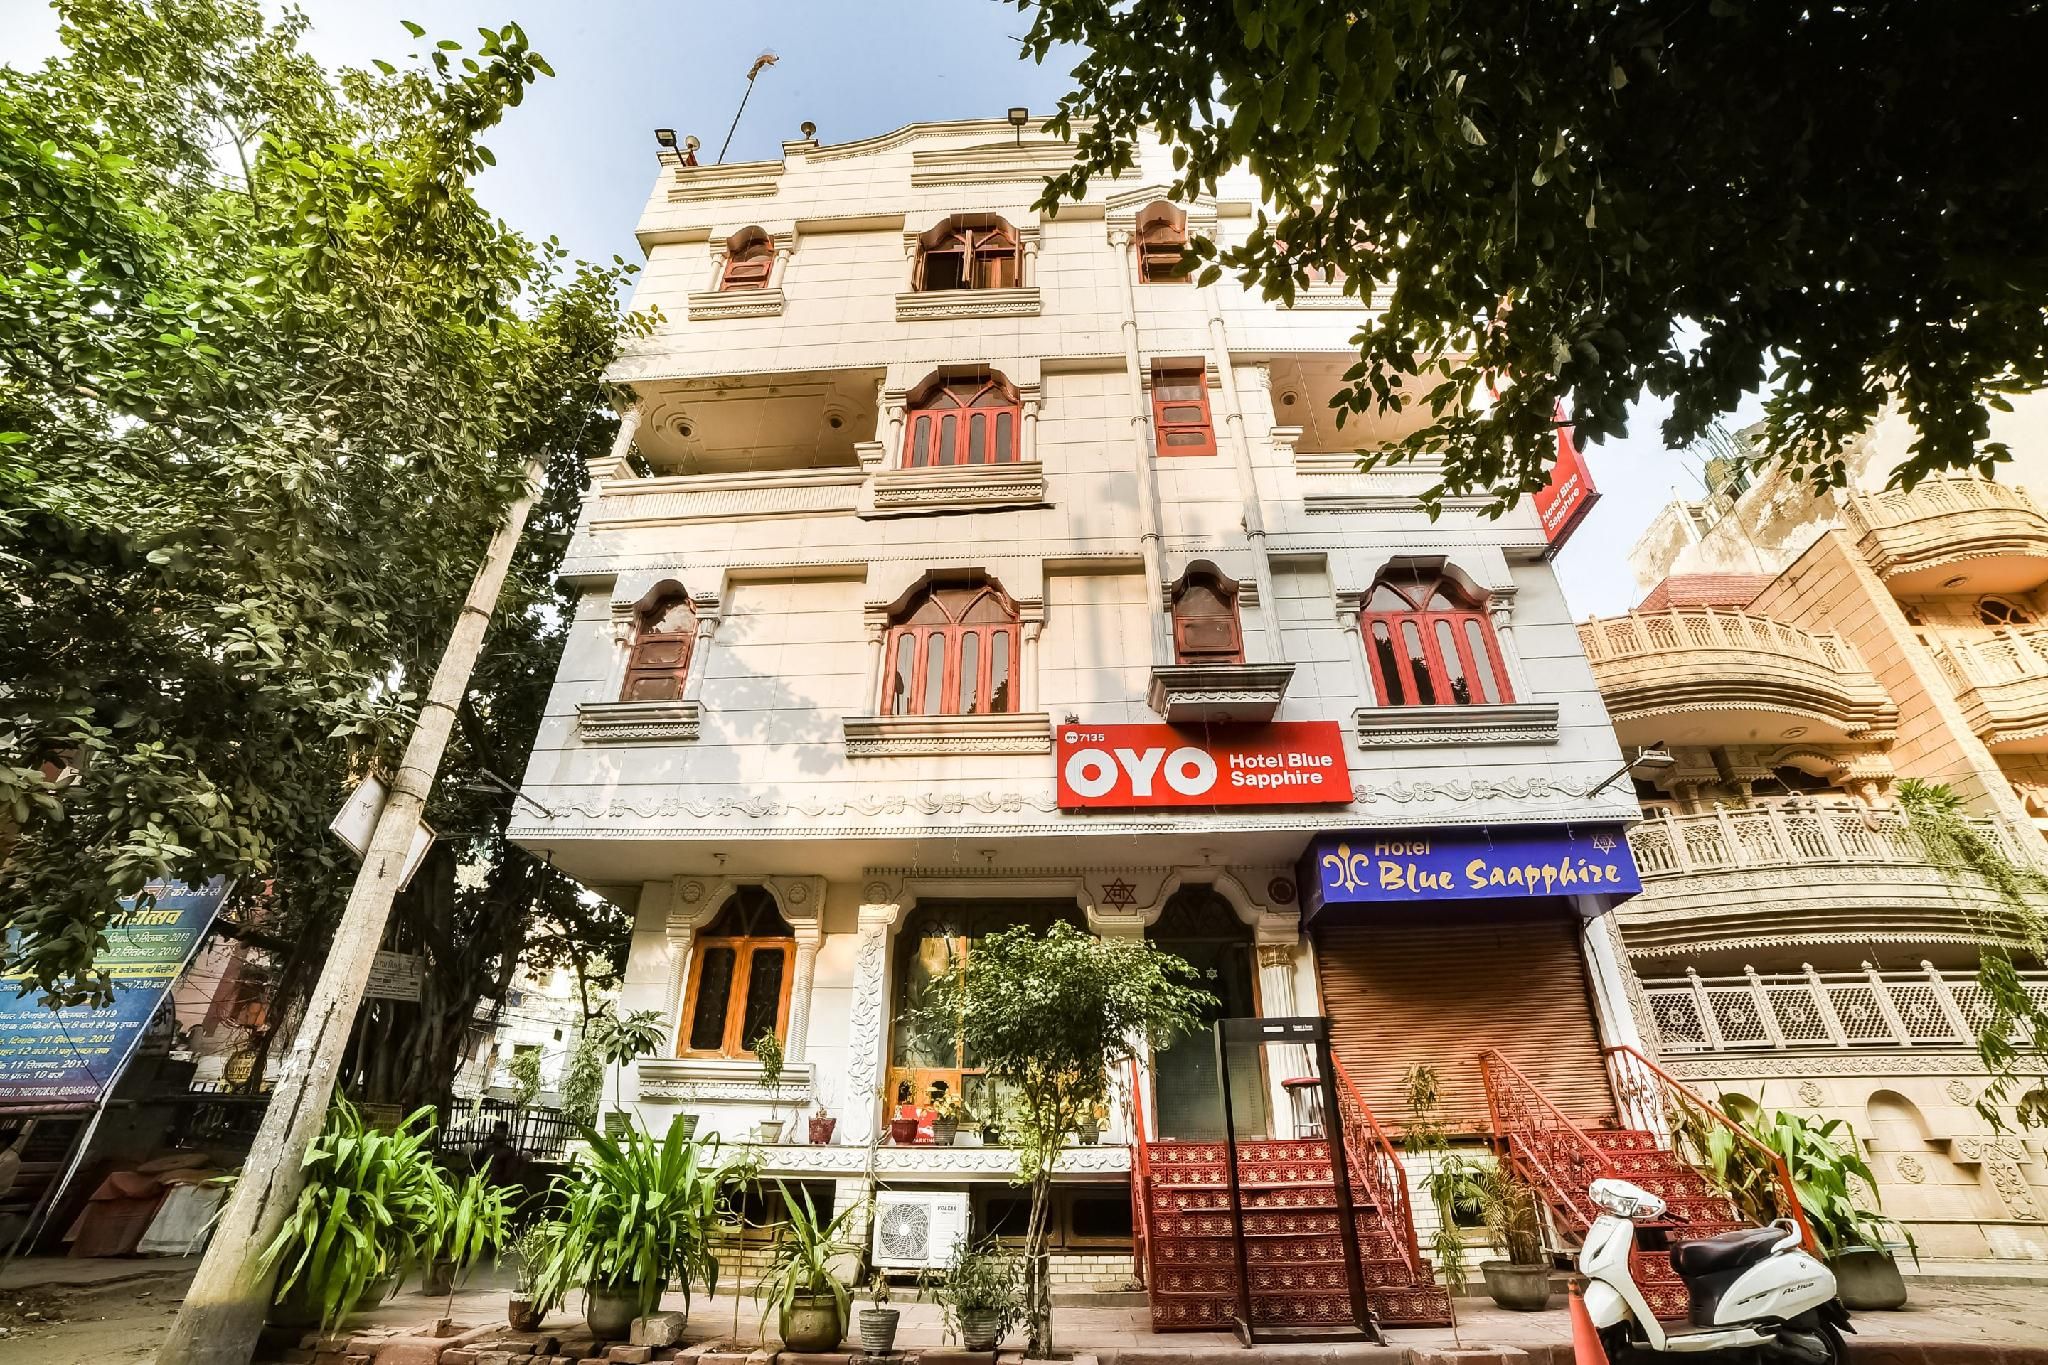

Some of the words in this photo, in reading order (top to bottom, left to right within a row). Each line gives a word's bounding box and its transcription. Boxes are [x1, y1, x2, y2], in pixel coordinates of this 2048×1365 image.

[1542, 492, 1562, 523] Hotel
[1559, 473, 1578, 498] Blue
[1548, 487, 1580, 531] Sapphire
[1079, 733, 1105, 742] 7135
[1230, 753, 1284, 769] Hotel
[1288, 753, 1333, 767] Blue
[1065, 747, 1218, 797] OYO
[1231, 770, 1323, 789] Sapphire
[1374, 839, 1430, 857] Hotel
[1377, 860, 1455, 892] Blue
[1465, 856, 1622, 894] Saapphire
[169, 932, 191, 942] 2019
[158, 946, 182, 956] 2019
[92, 1010, 118, 1018] 2019
[89, 1034, 115, 1043] 2019
[17, 1047, 32, 1055] 12
[10, 1060, 24, 1069] 11
[61, 1059, 89, 1068] 2019
[34, 1070, 48, 1079] 10
